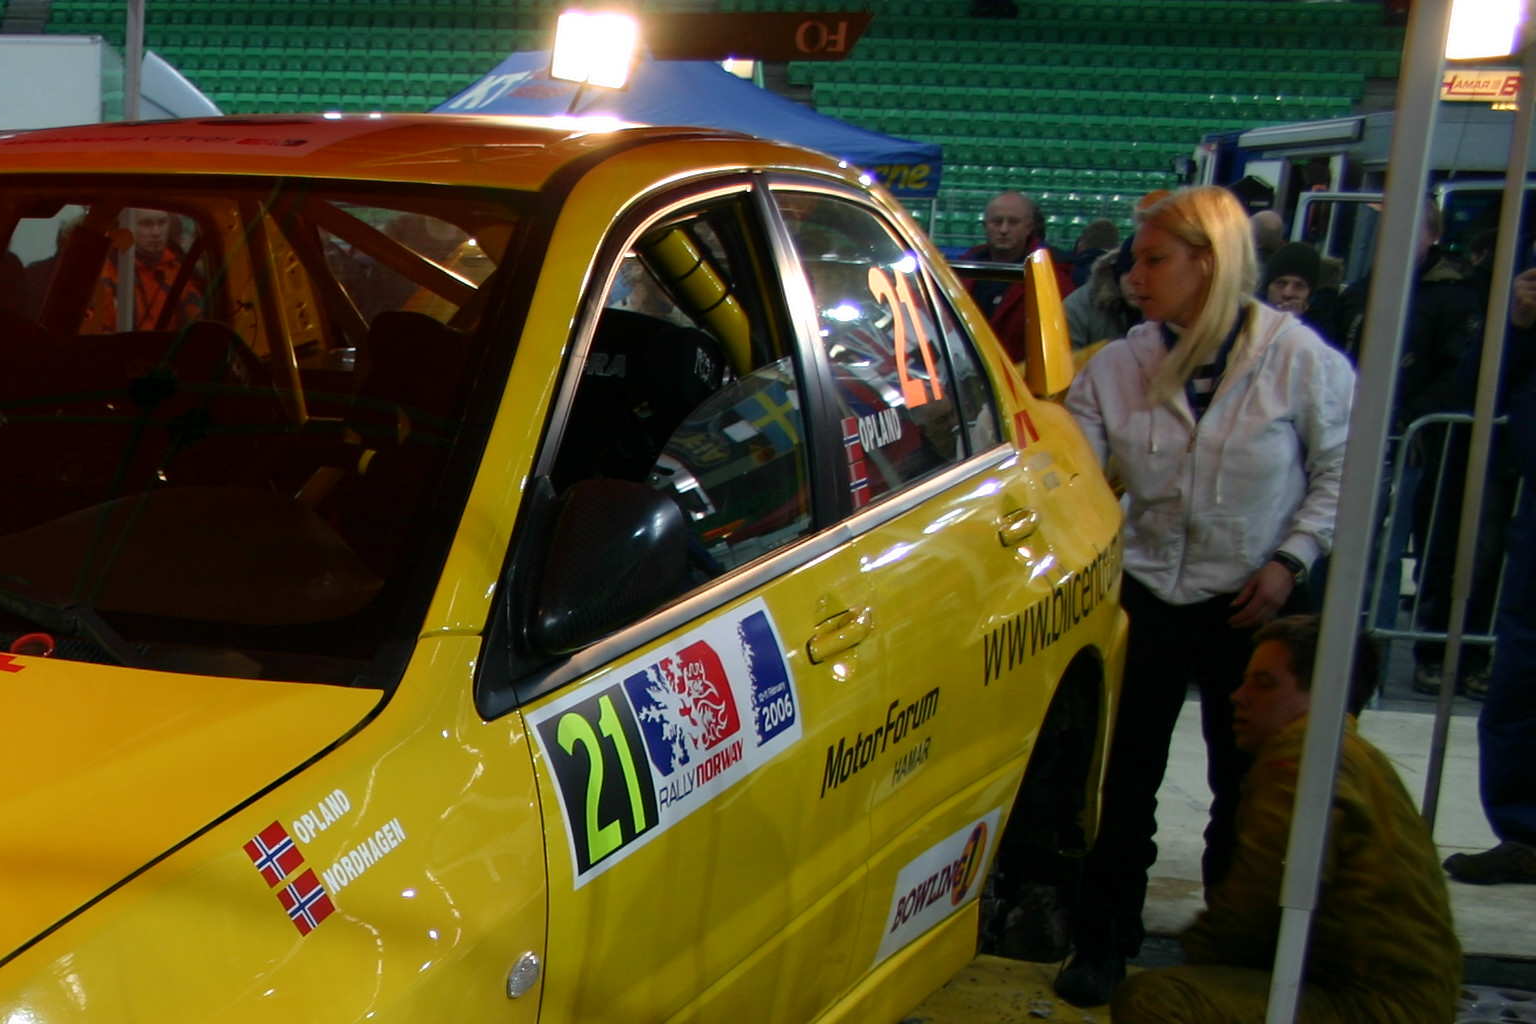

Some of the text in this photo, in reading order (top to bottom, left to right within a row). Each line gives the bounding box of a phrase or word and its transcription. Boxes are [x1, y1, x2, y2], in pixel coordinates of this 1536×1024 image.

[868, 266, 944, 410] 21
[858, 407, 902, 453] OPLAND
[761, 693, 793, 733] 2006
[557, 694, 646, 865] 21
[891, 736, 932, 787] HAMAR
[292, 788, 351, 844] OPLAND
[322, 817, 406, 894] NORDHAGEN
